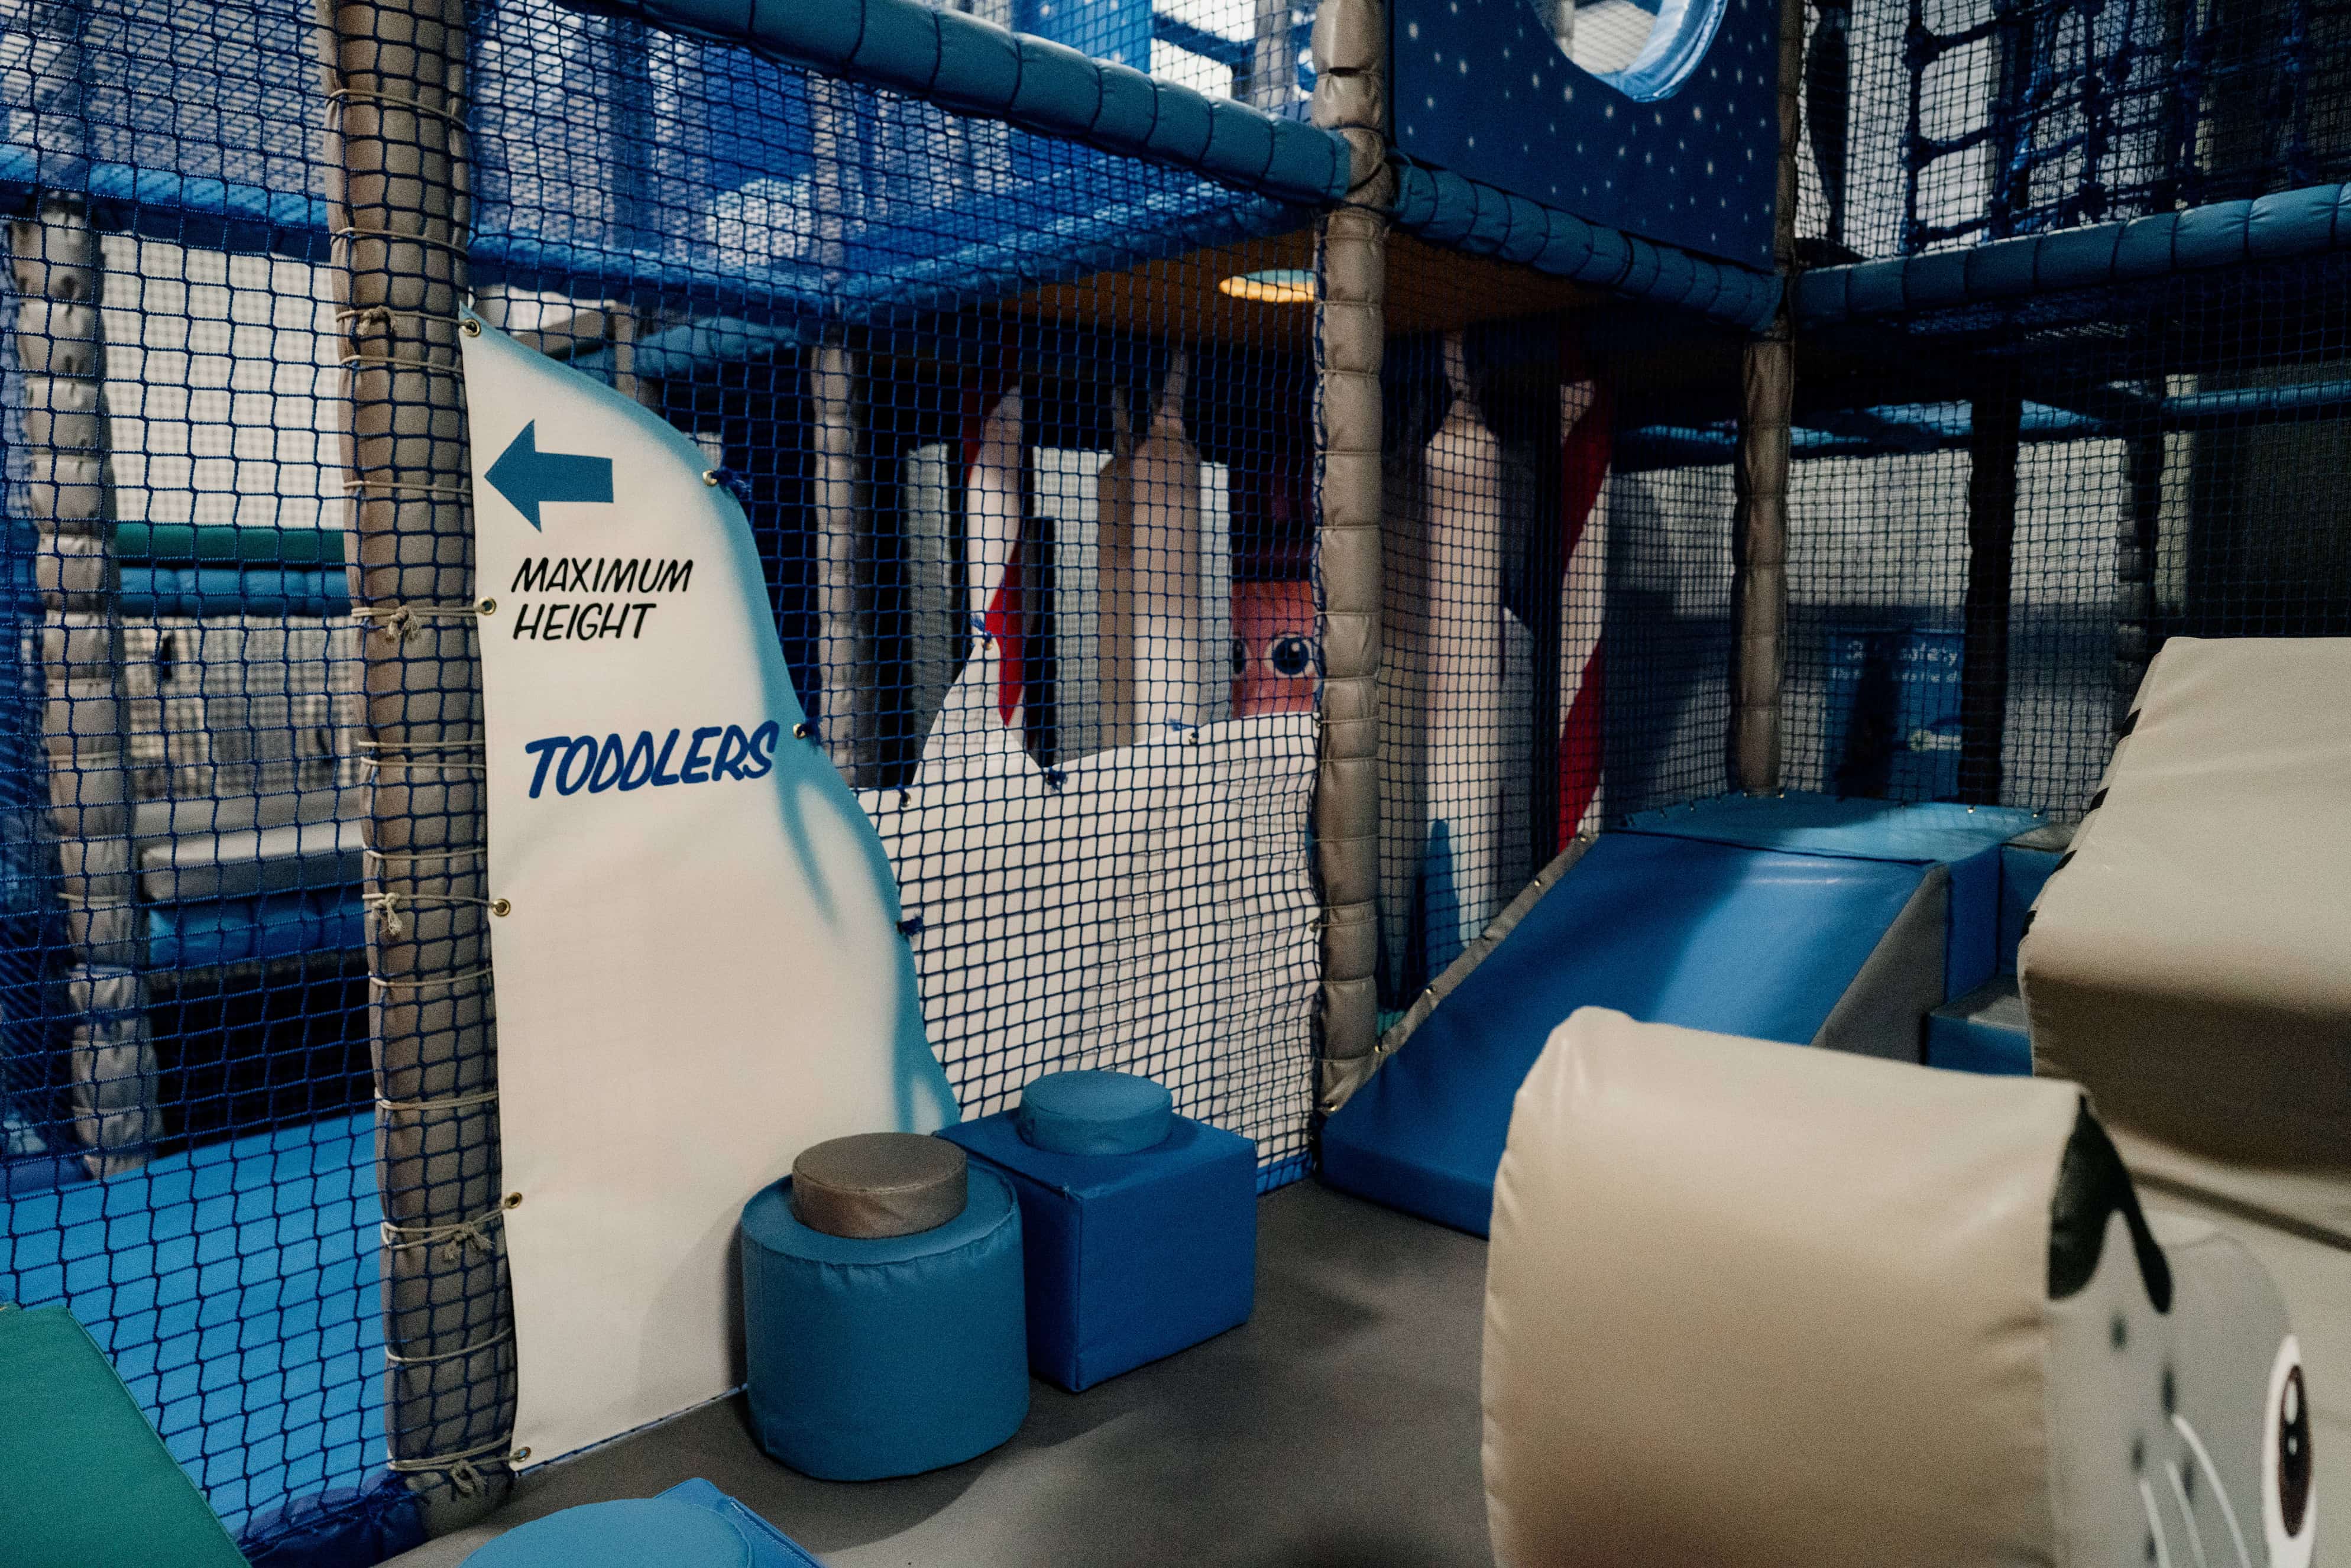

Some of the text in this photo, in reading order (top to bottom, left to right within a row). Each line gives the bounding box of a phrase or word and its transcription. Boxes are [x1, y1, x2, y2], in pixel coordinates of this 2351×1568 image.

[511, 557, 694, 593] MAXIMUM
[513, 602, 656, 640] HEIGHT
[525, 720, 780, 799] TODDLERS
